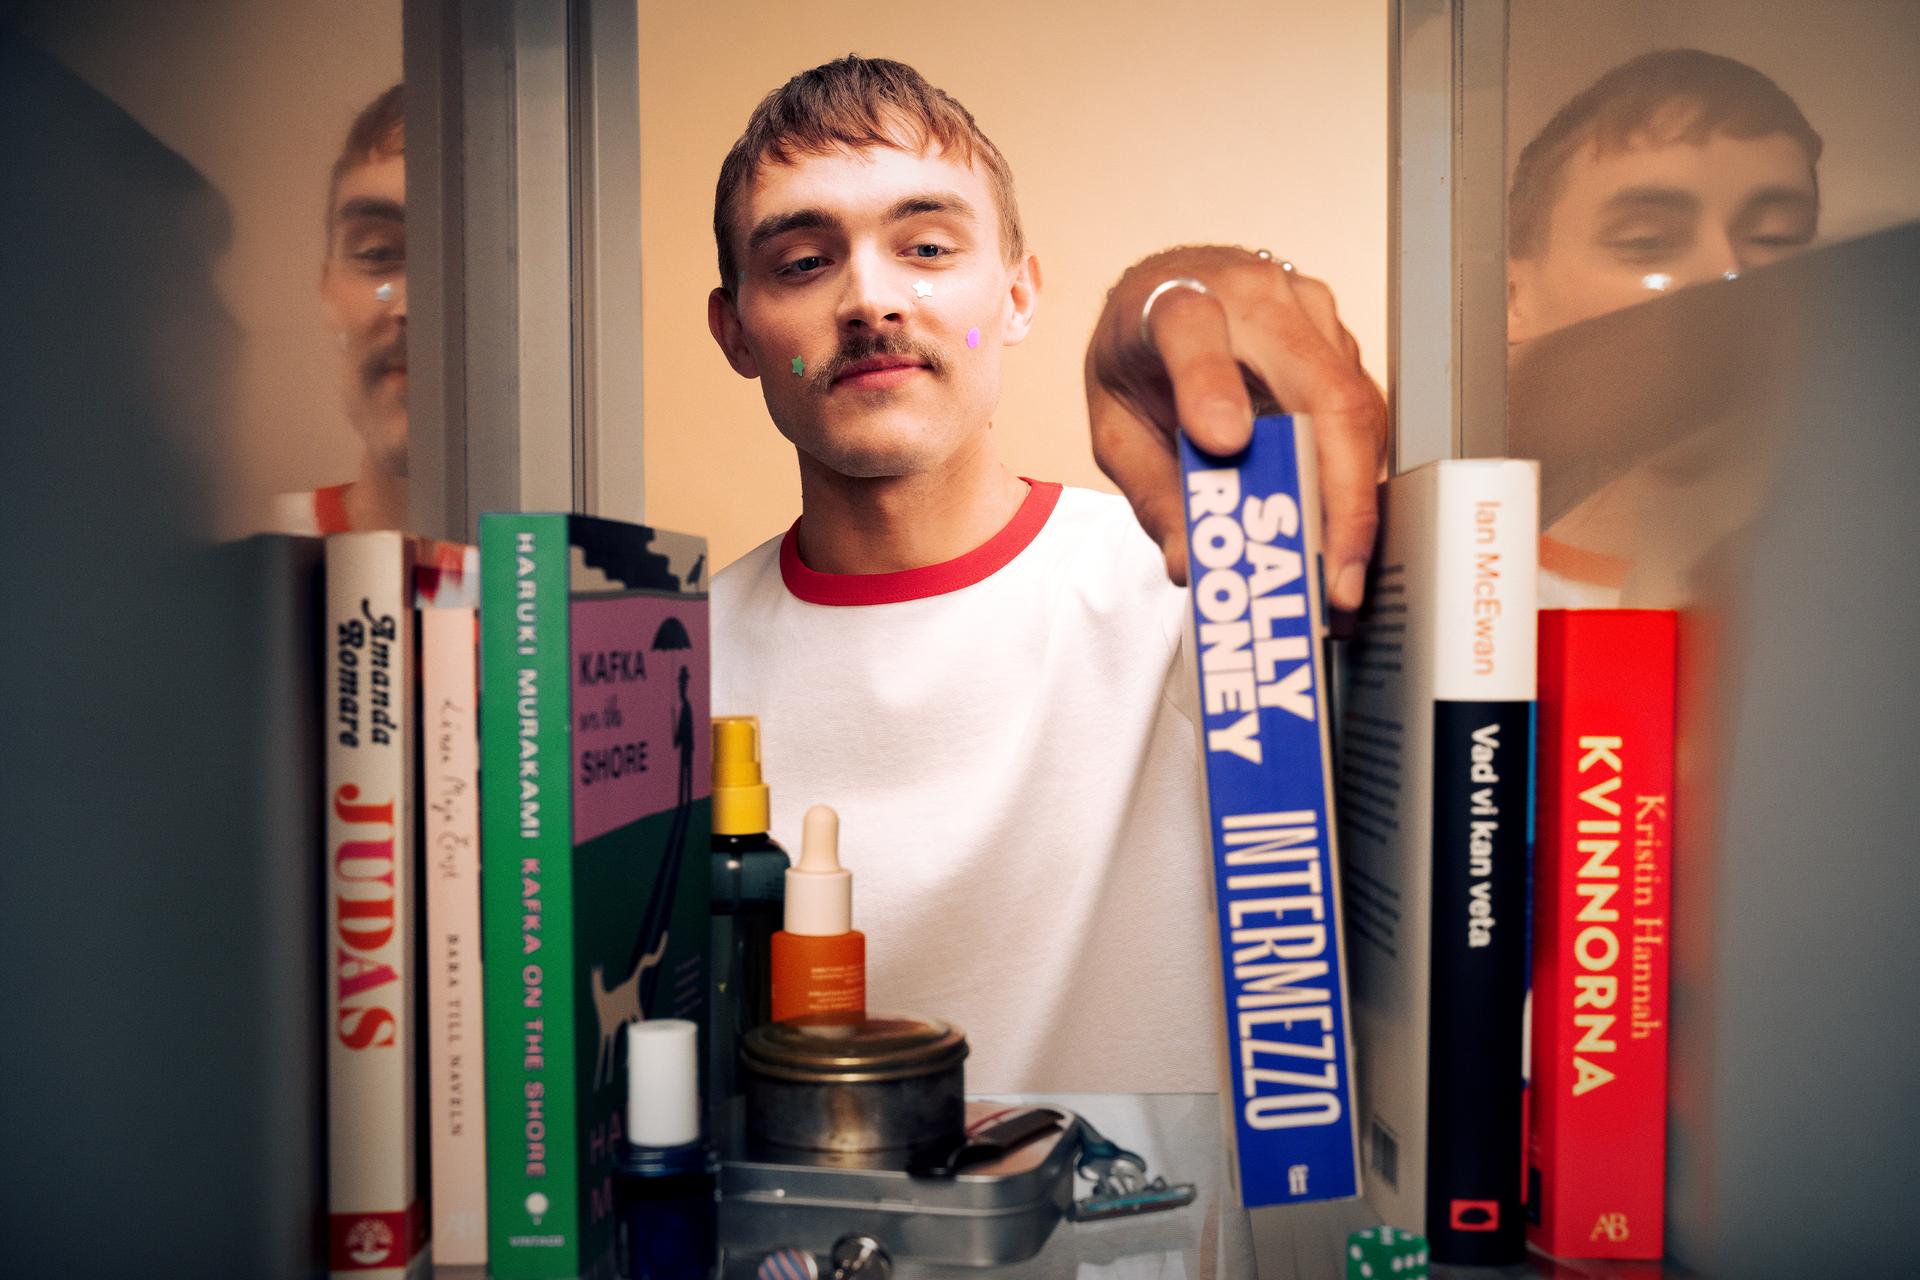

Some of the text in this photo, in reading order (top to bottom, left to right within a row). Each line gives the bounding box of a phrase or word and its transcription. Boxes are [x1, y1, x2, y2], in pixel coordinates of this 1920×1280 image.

[338, 618, 365, 748] Romare
[363, 598, 397, 747] Amanda
[579, 650, 646, 686] KAFKA
[1187, 468, 1262, 765] ROONEY
[1241, 491, 1315, 722] SALLY
[1473, 500, 1502, 677] Ian McEwan
[516, 532, 545, 1177] HARUKI MURAKAMI KAFKA ON THE SHORE
[581, 741, 648, 785] SHORE
[1467, 723, 1501, 948] Vad vi kan veta
[335, 783, 399, 1051] JUDAS
[1222, 810, 1342, 1131] INTERMEZZO
[1572, 736, 1623, 1097] KVINNORNA
[1631, 794, 1666, 1041] Kristin Hannah
[1589, 1212, 1631, 1242] AB
